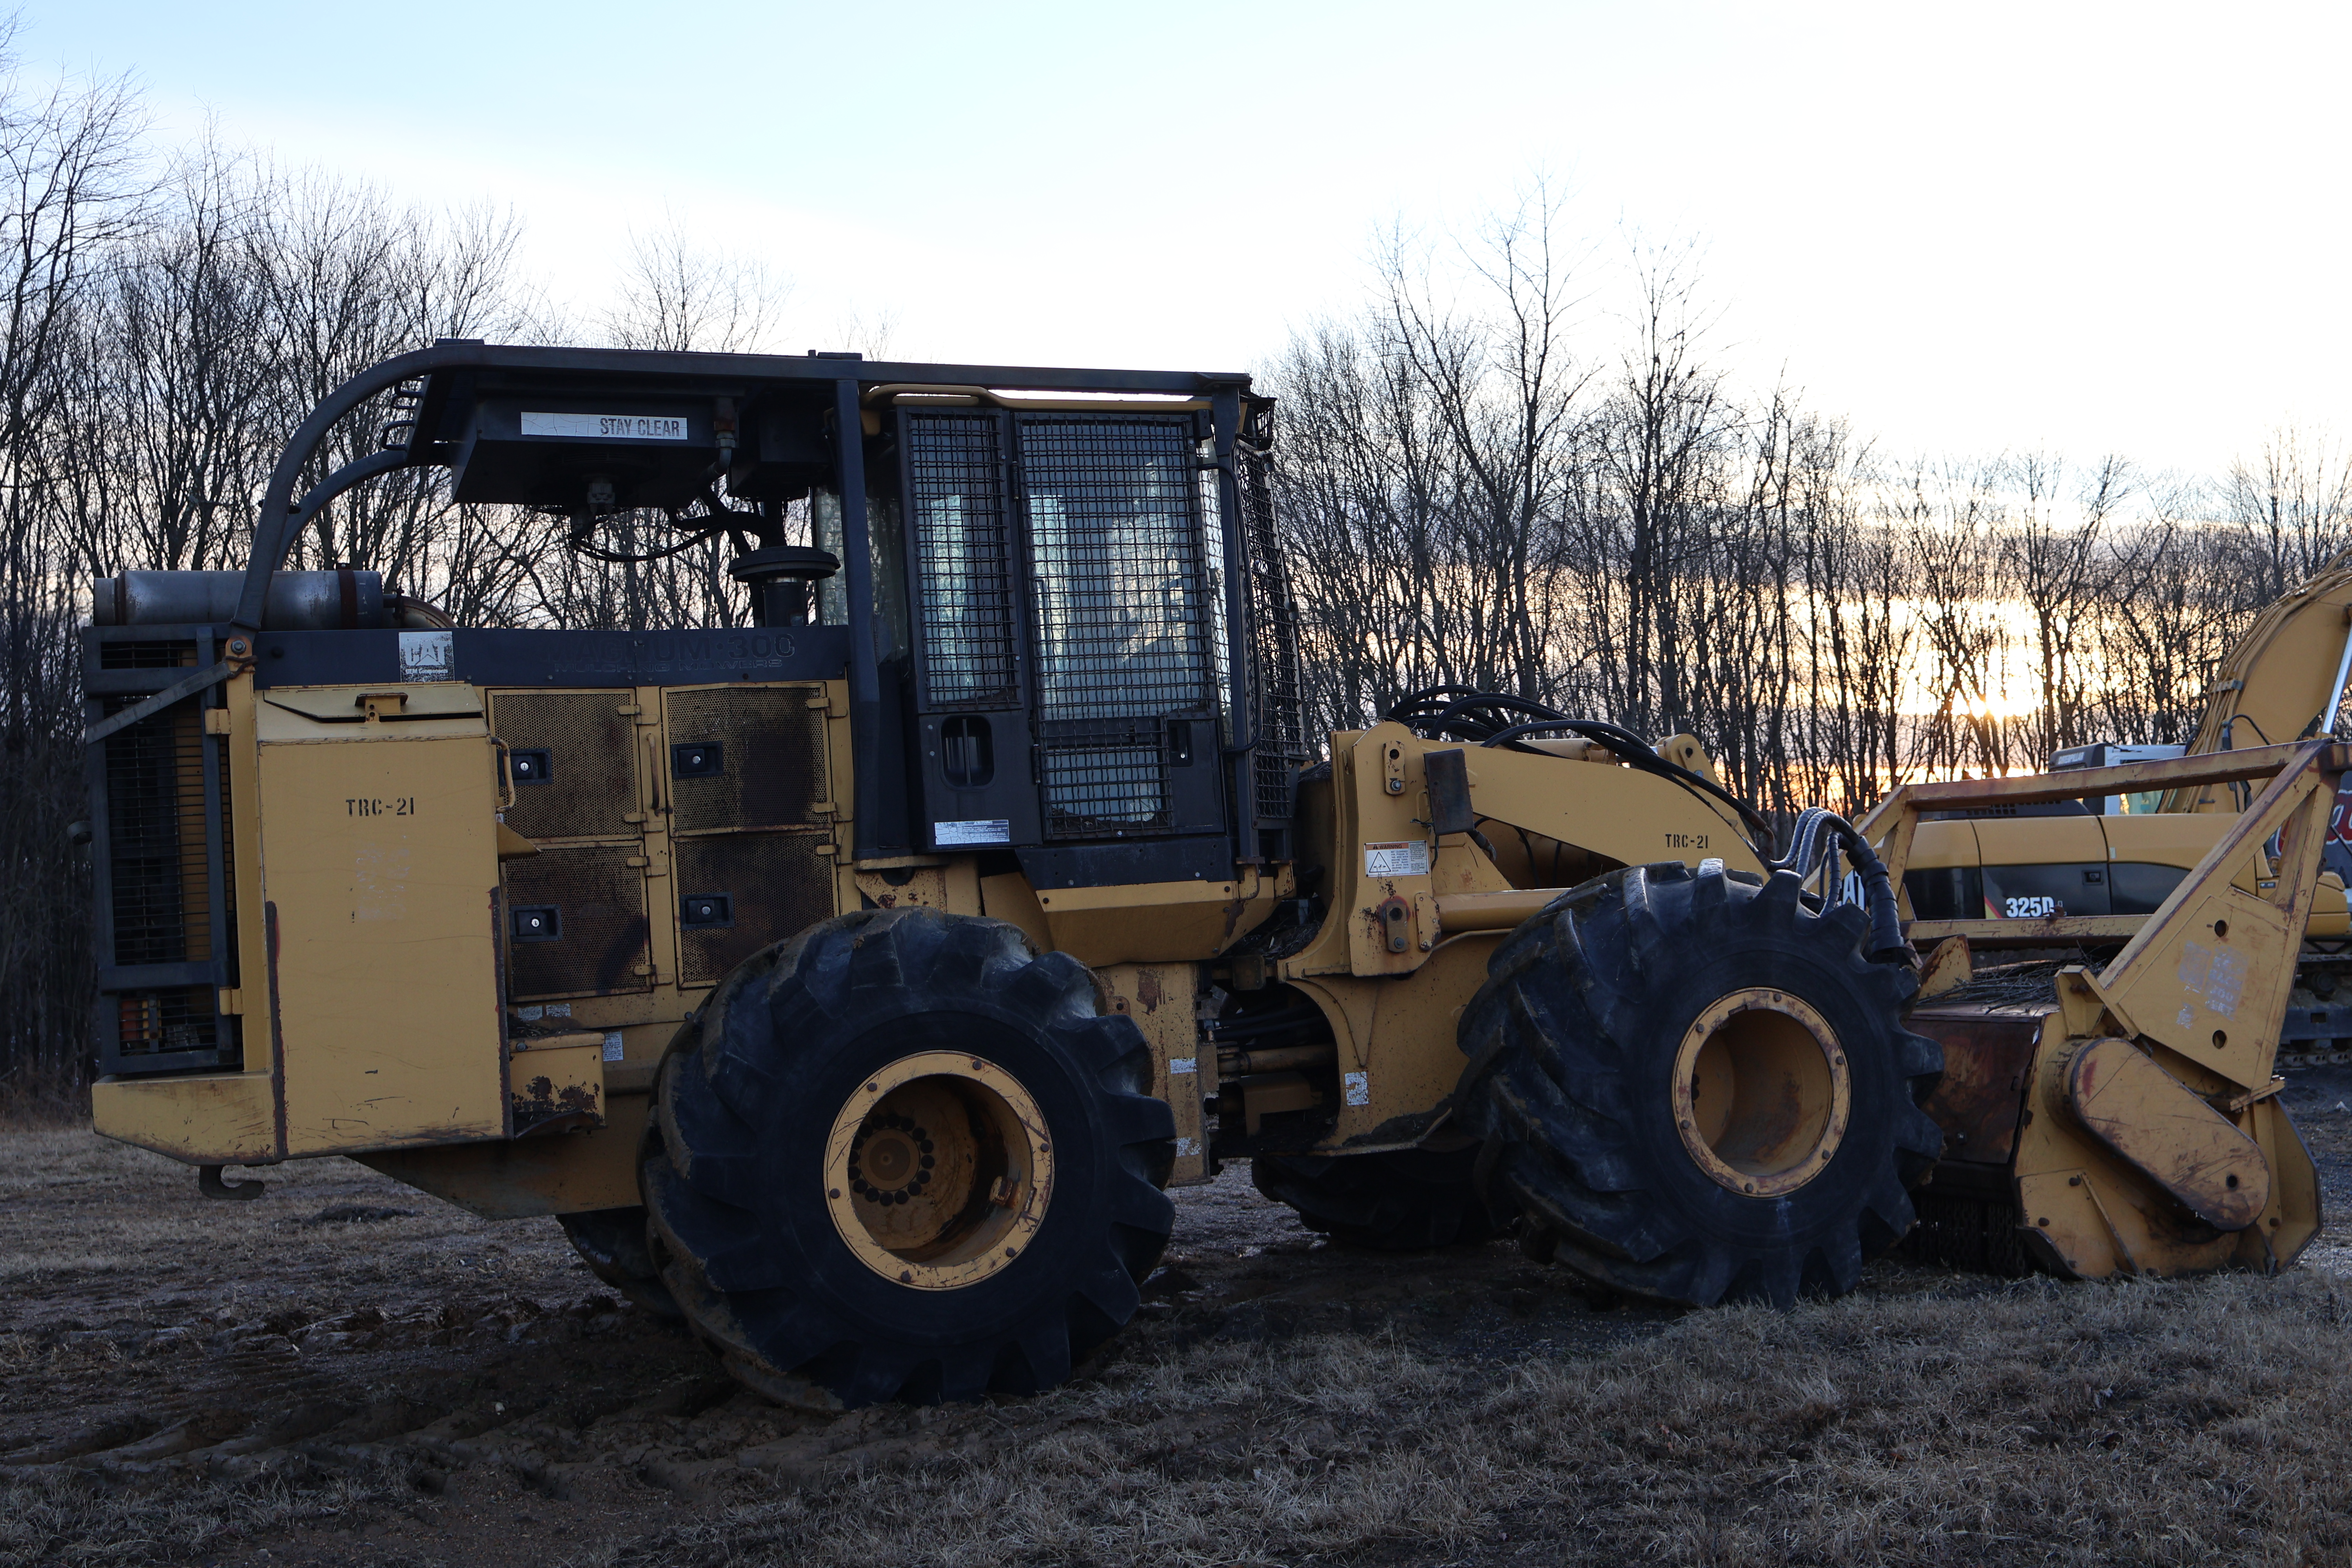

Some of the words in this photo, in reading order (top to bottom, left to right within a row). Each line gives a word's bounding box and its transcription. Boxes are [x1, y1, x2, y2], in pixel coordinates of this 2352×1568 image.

[600, 418, 632, 436] STAY
[638, 419, 679, 437] CLEAR
[554, 663, 670, 673] MULCHING
[679, 659, 782, 671] MOWERS
[346, 797, 414, 817] TRC-21
[1665, 834, 1708, 849] TRC-21
[2006, 896, 2055, 918] 325D
